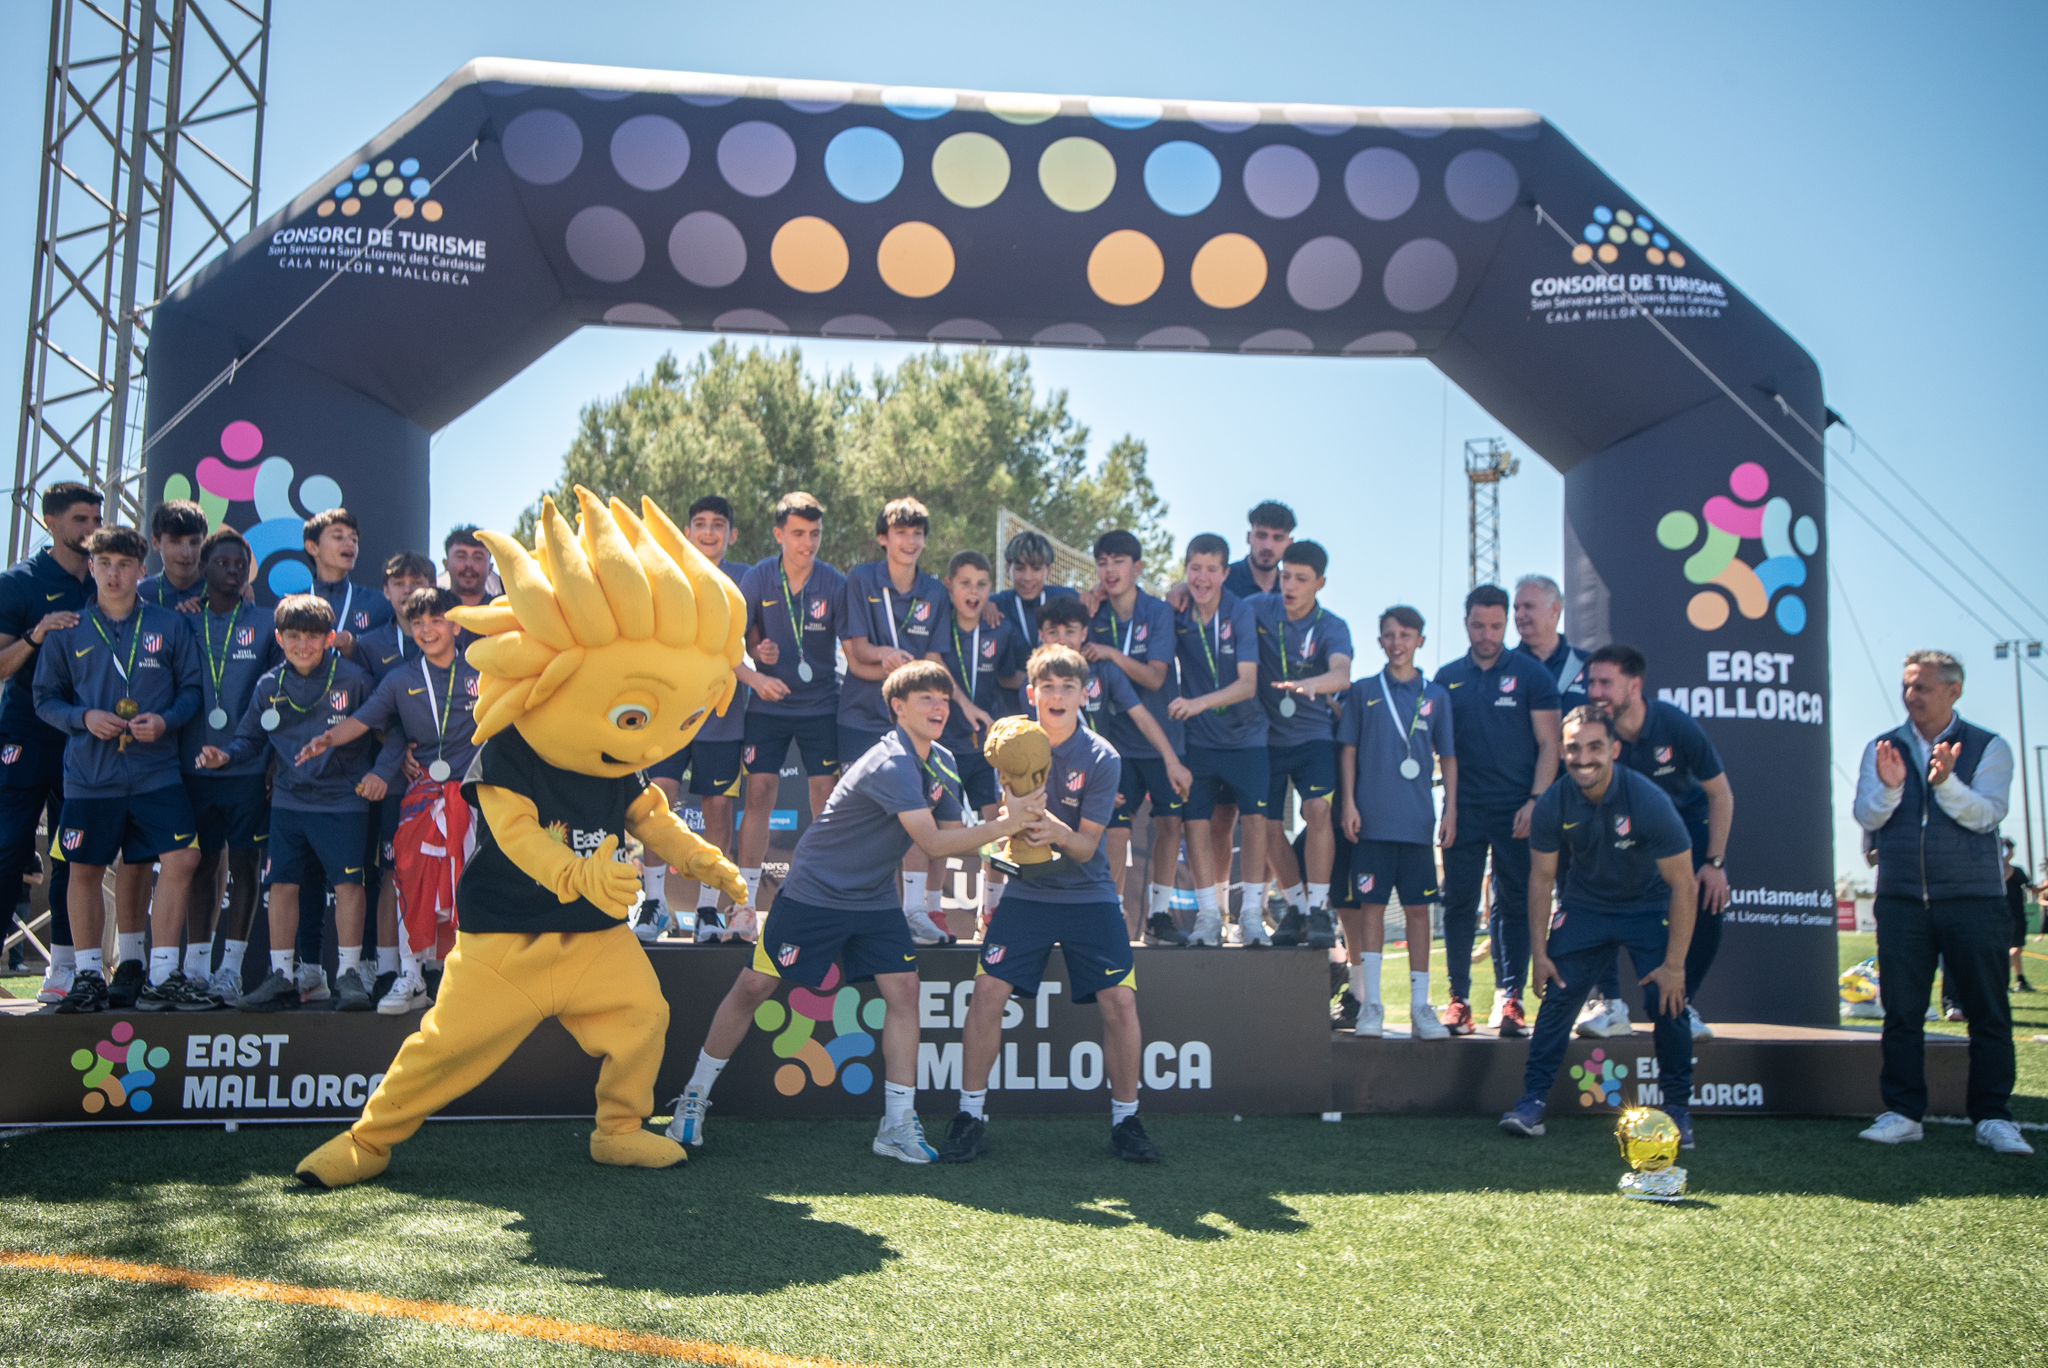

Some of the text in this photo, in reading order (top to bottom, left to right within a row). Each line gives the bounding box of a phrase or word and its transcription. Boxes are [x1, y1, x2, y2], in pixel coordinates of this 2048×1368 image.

[268, 245, 287, 256] Son
[289, 243, 328, 256] Servera
[337, 244, 362, 257] Sant
[409, 252, 430, 267] des
[432, 253, 487, 273] Cardassar
[273, 226, 487, 260] CONSORCI DE TURISME
[279, 257, 469, 287] CALA MILLOR MALLORCA
[1530, 274, 1725, 298] CONSORCI DE TURISME
[1545, 305, 1721, 325] CALA MILLOR MALLORCA
[1707, 650, 1795, 684] EAST
[1657, 686, 1824, 725] MALLORCA
[572, 828, 607, 850] East
[1724, 885, 1819, 908] untament
[186, 1034, 289, 1068] EAST
[917, 1041, 1212, 1091] MLLOCA
[1637, 1083, 1764, 1106] MLORCA
